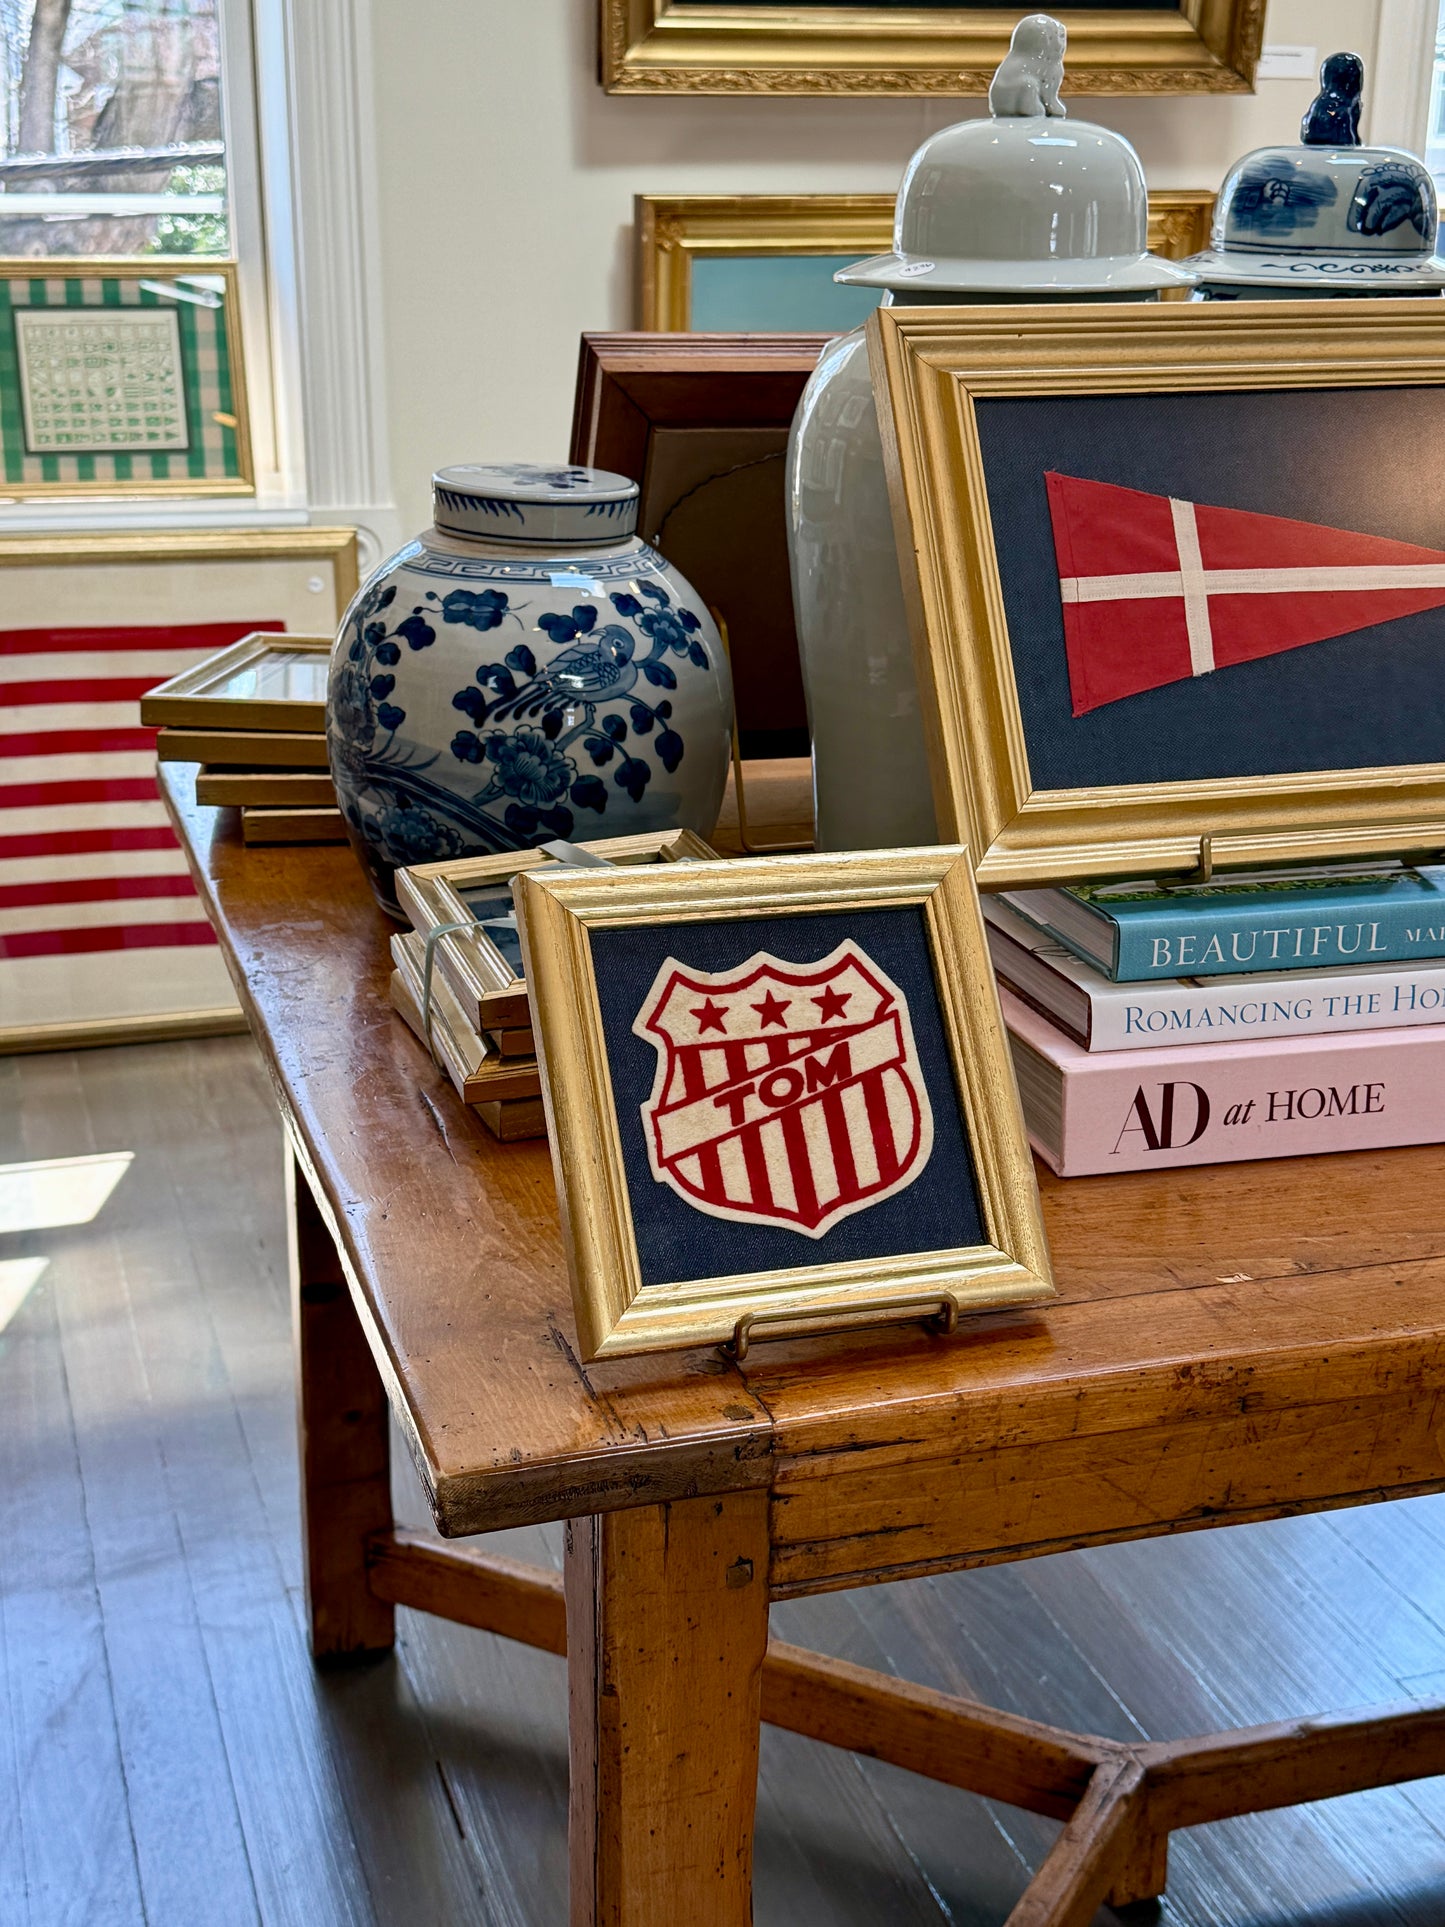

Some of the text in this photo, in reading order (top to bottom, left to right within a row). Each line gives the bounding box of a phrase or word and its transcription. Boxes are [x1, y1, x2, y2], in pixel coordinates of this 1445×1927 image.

[1150, 922, 1387, 968] BEAUTIFUL
[1124, 998, 1313, 1034] ROMANCING
[1323, 993, 1381, 1017] THE
[713, 1041, 852, 1127] TOM
[1108, 1081, 1386, 1155] AD at HOME
